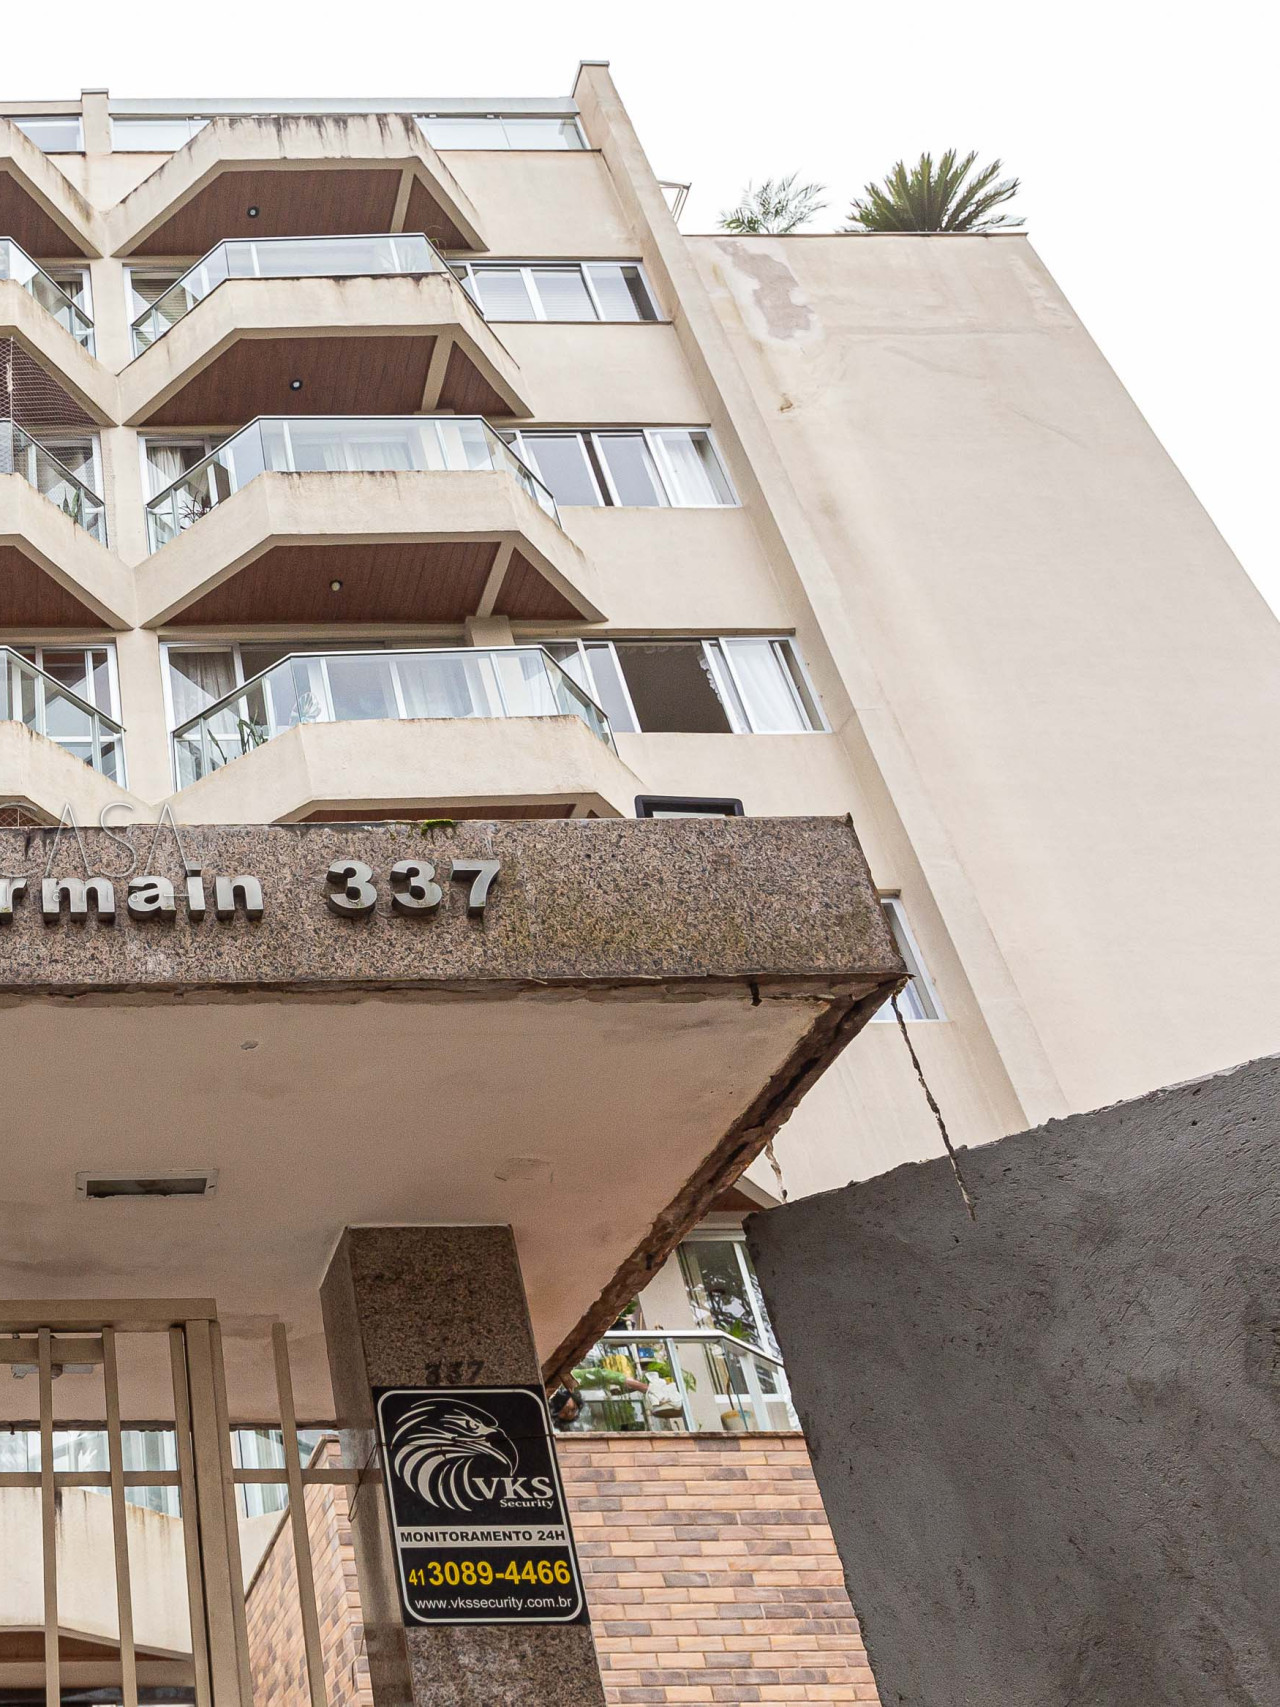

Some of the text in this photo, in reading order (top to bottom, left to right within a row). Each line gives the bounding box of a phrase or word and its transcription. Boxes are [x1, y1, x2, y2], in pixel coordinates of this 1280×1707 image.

[325, 858, 502, 918] 337
[472, 1476, 554, 1500] VKS
[500, 1499, 554, 1509] Security
[400, 1530, 566, 1542] MONITORAMENTO 24H
[427, 1560, 571, 1586] 3089-4466
[415, 1595, 572, 1611] www.vkssecurity.com.br
